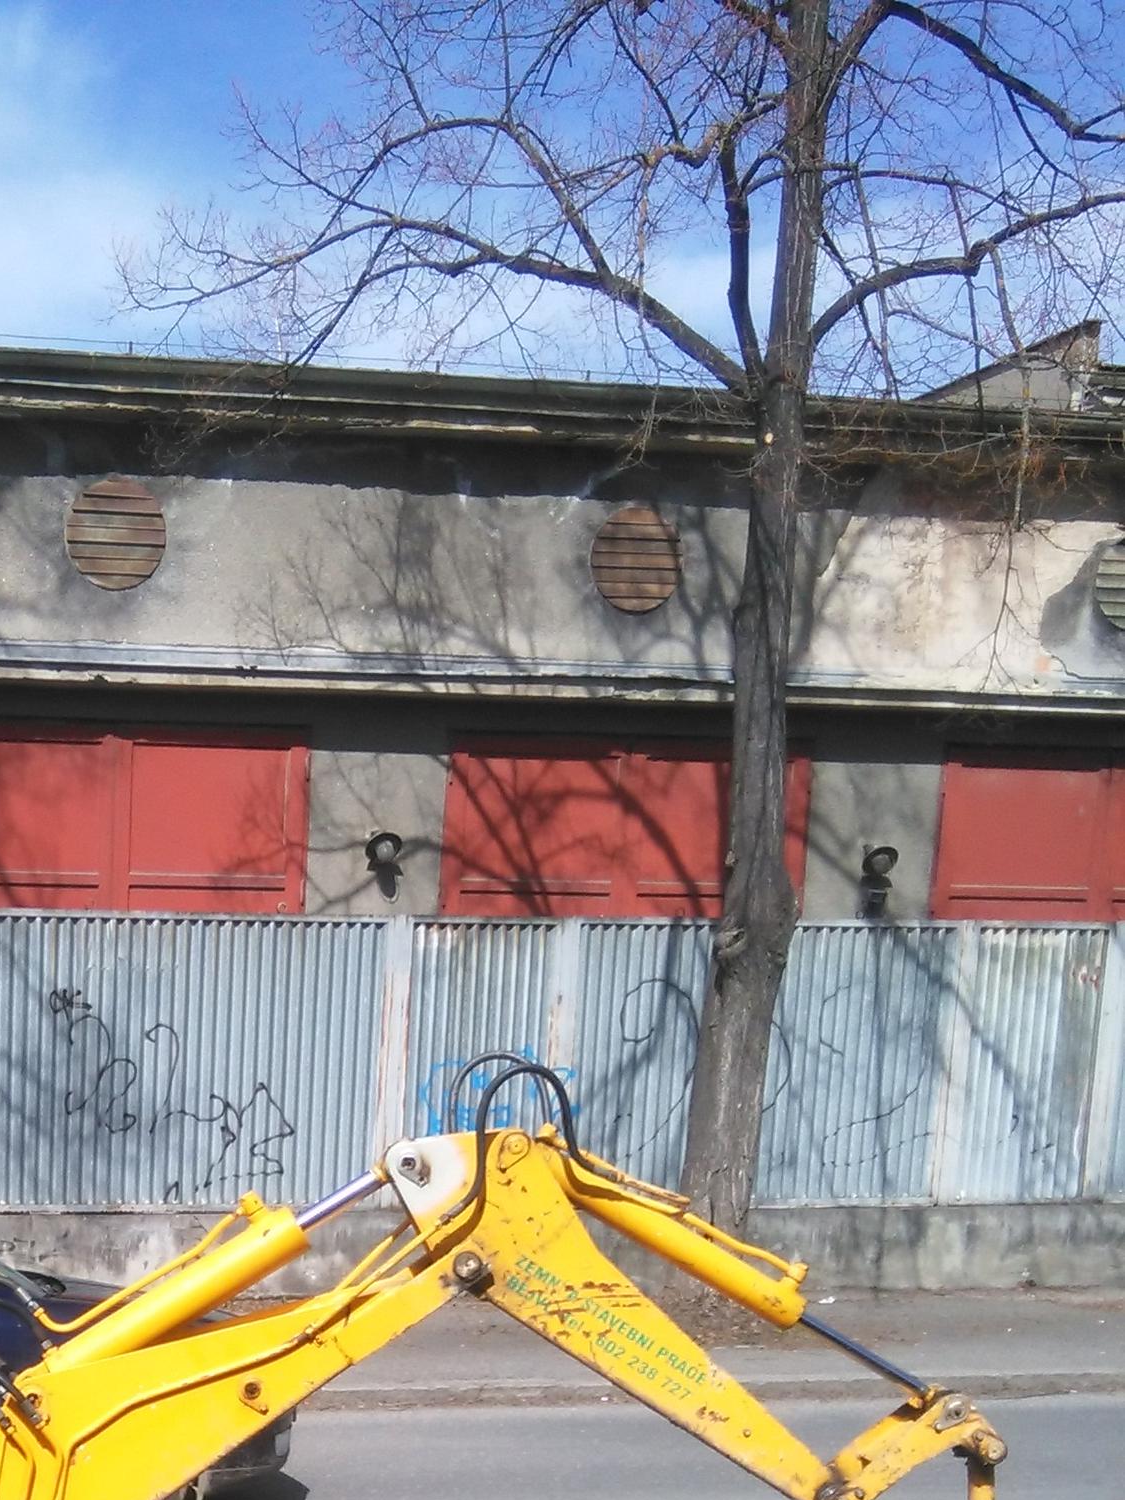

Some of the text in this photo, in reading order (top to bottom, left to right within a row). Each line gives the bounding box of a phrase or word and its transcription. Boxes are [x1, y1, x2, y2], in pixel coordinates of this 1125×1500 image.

[594, 1334, 626, 1360] 602
[627, 1355, 659, 1381] 238
[660, 1376, 692, 1400] 727
